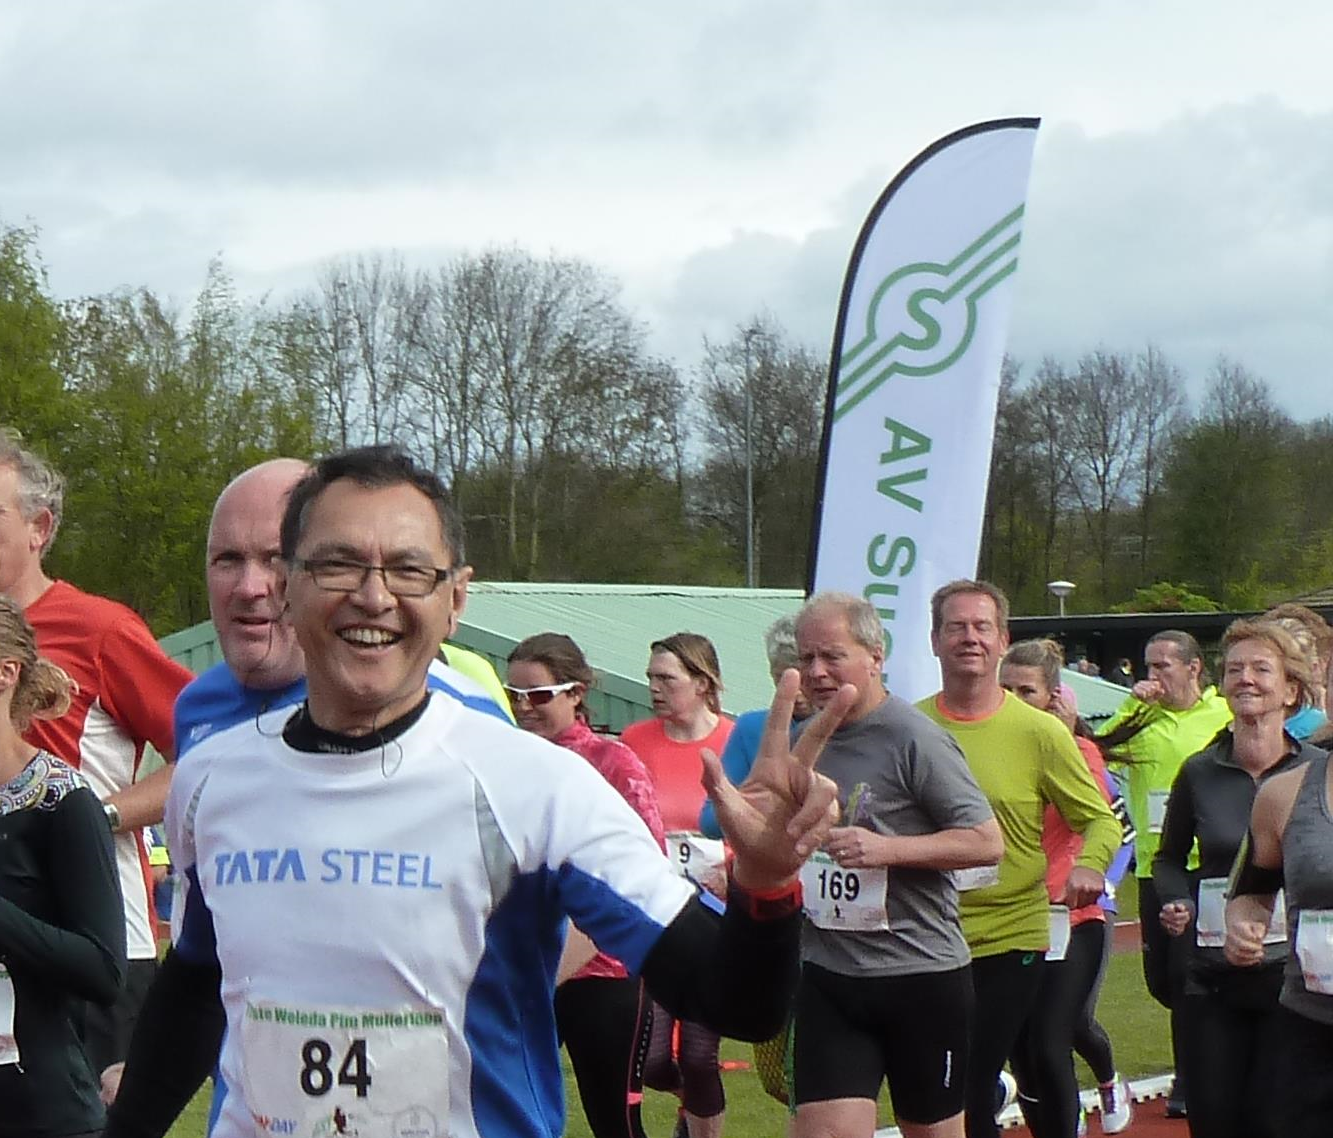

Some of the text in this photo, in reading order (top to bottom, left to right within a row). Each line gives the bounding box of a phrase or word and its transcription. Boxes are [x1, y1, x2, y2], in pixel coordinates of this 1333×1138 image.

[876, 416, 932, 513] AV
[214, 848, 443, 889] TATA STEEL
[817, 868, 860, 902] 169
[300, 1039, 373, 1098] 84
